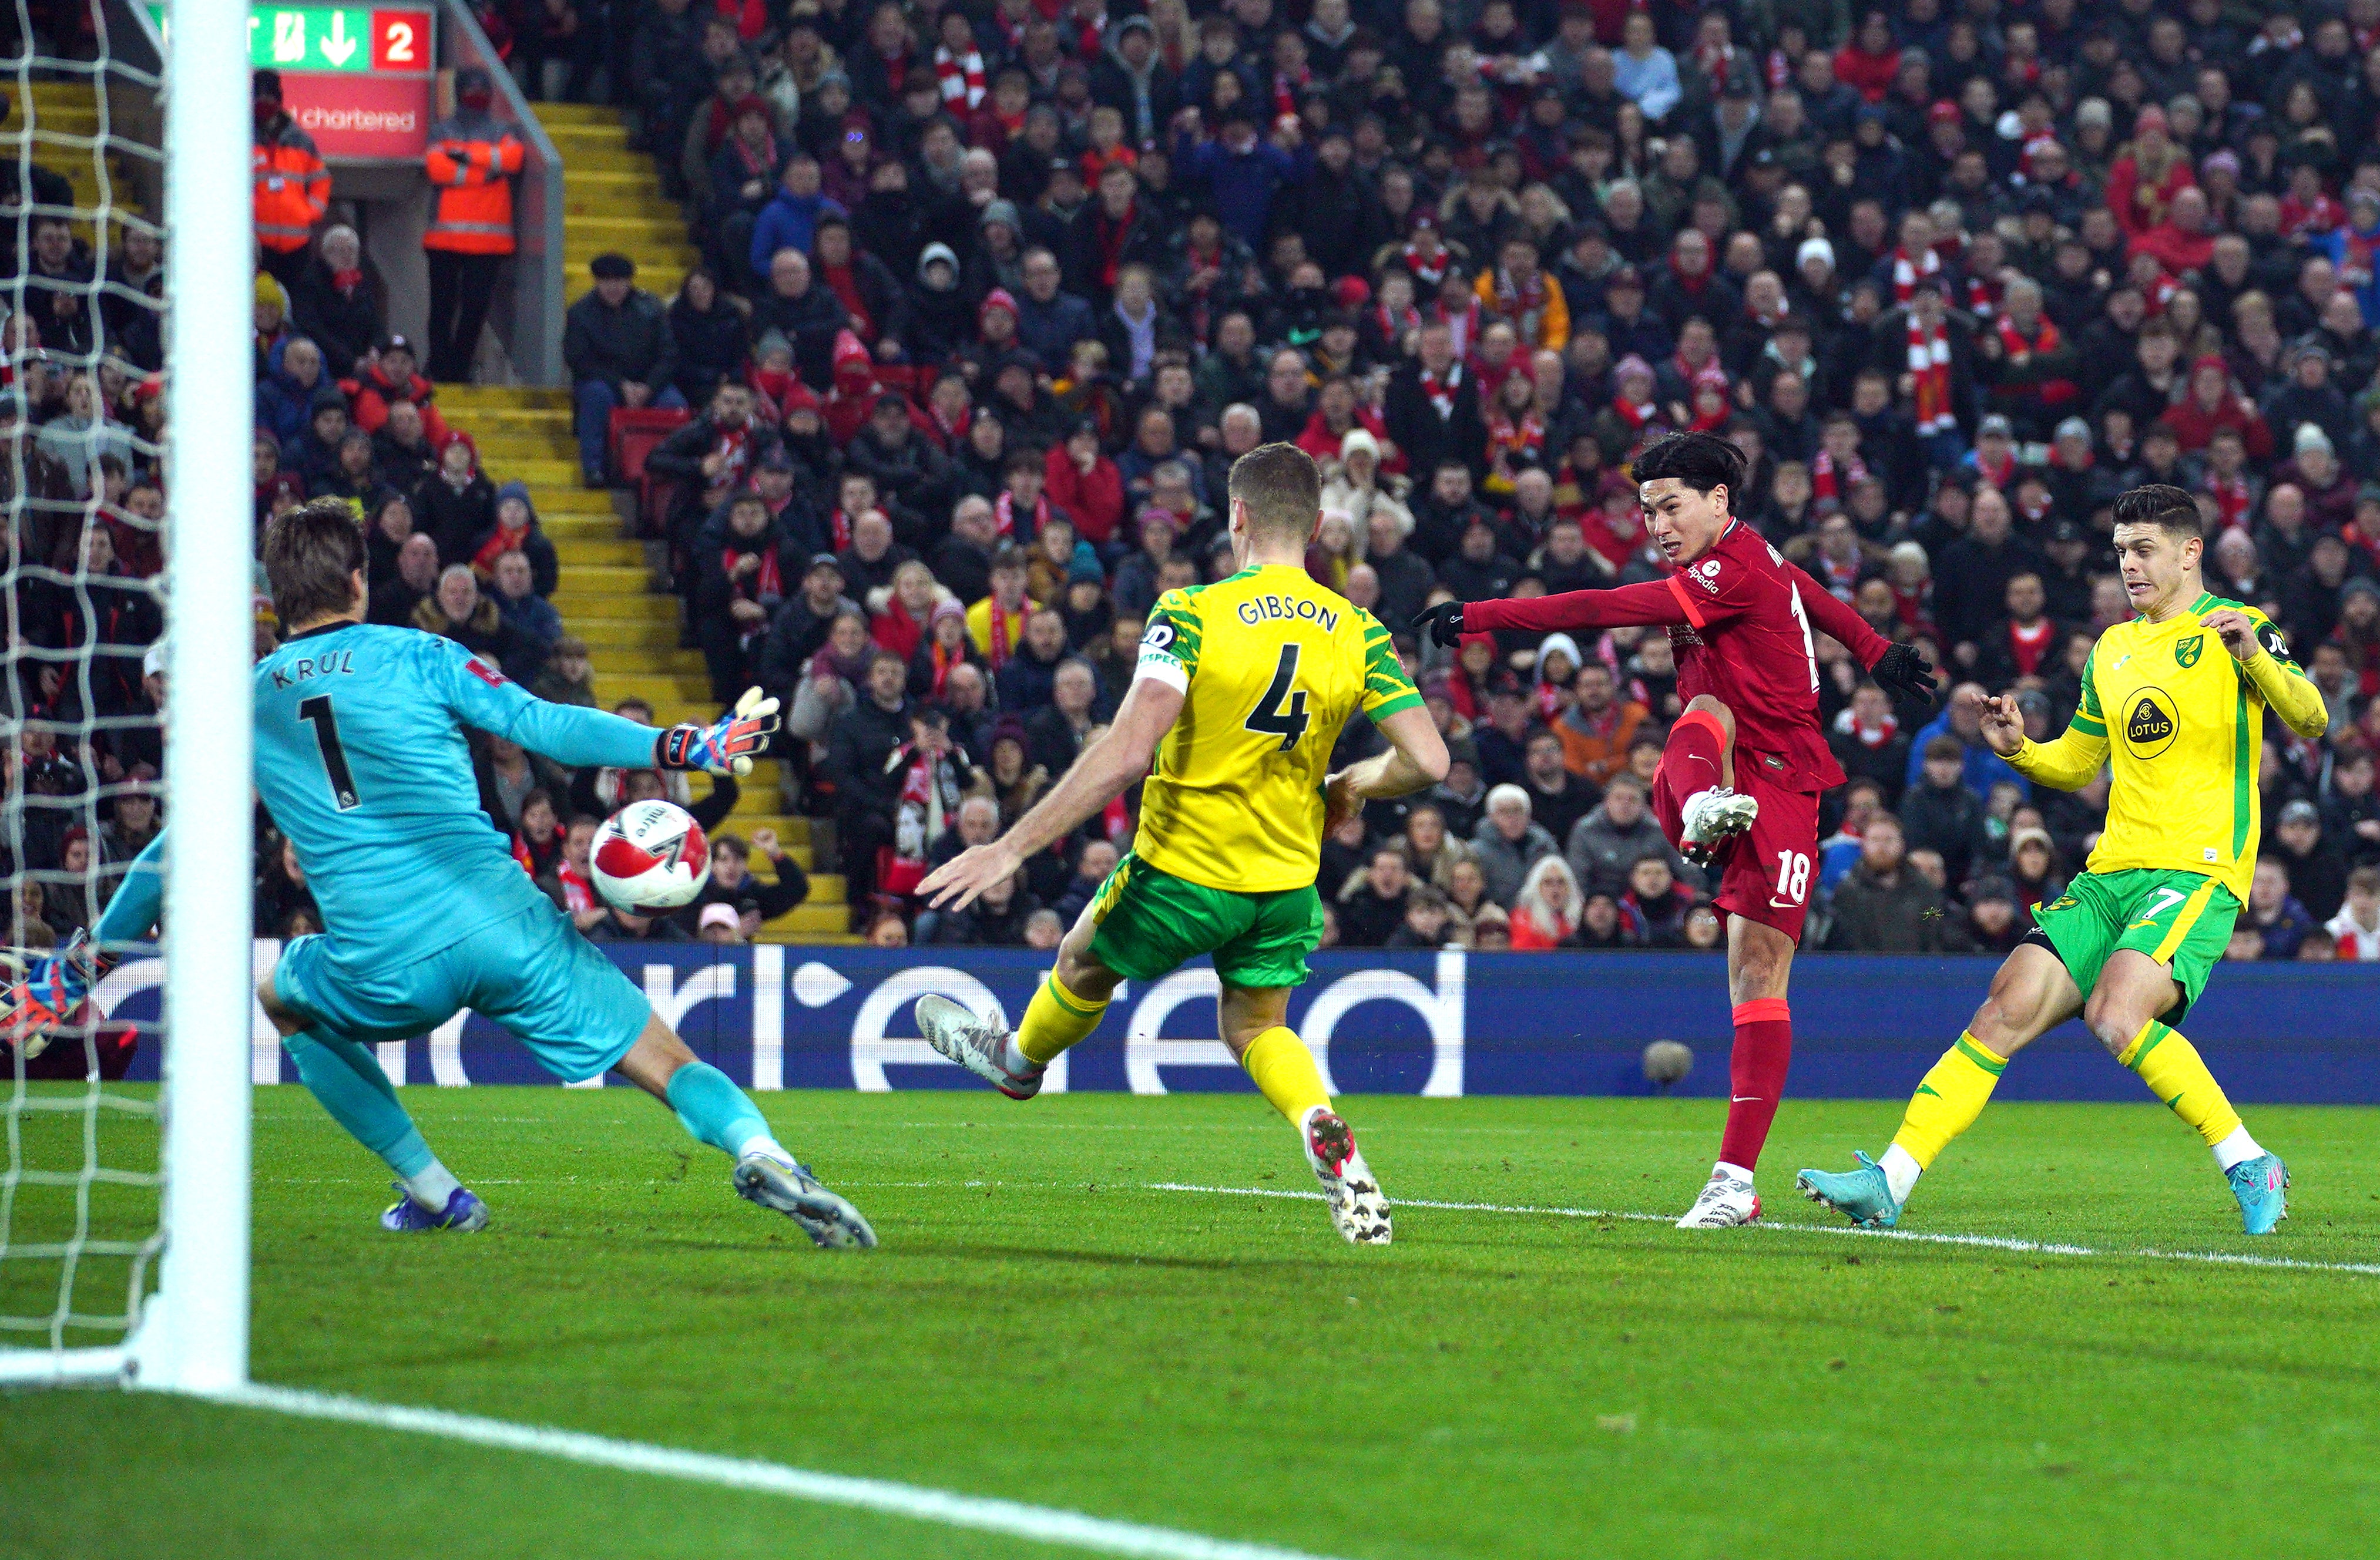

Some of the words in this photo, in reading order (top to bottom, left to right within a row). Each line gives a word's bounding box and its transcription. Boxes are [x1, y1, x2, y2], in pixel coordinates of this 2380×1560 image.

[386, 21, 414, 62] 2
[300, 107, 415, 133] chartered
[1238, 595, 1338, 632] GIBSON
[271, 651, 354, 690] KRUL
[1244, 643, 1312, 752] 4
[2130, 721, 2169, 738] LOTUS
[297, 693, 363, 813] 1
[636, 806, 667, 838] mitre
[1777, 849, 1811, 905] 18
